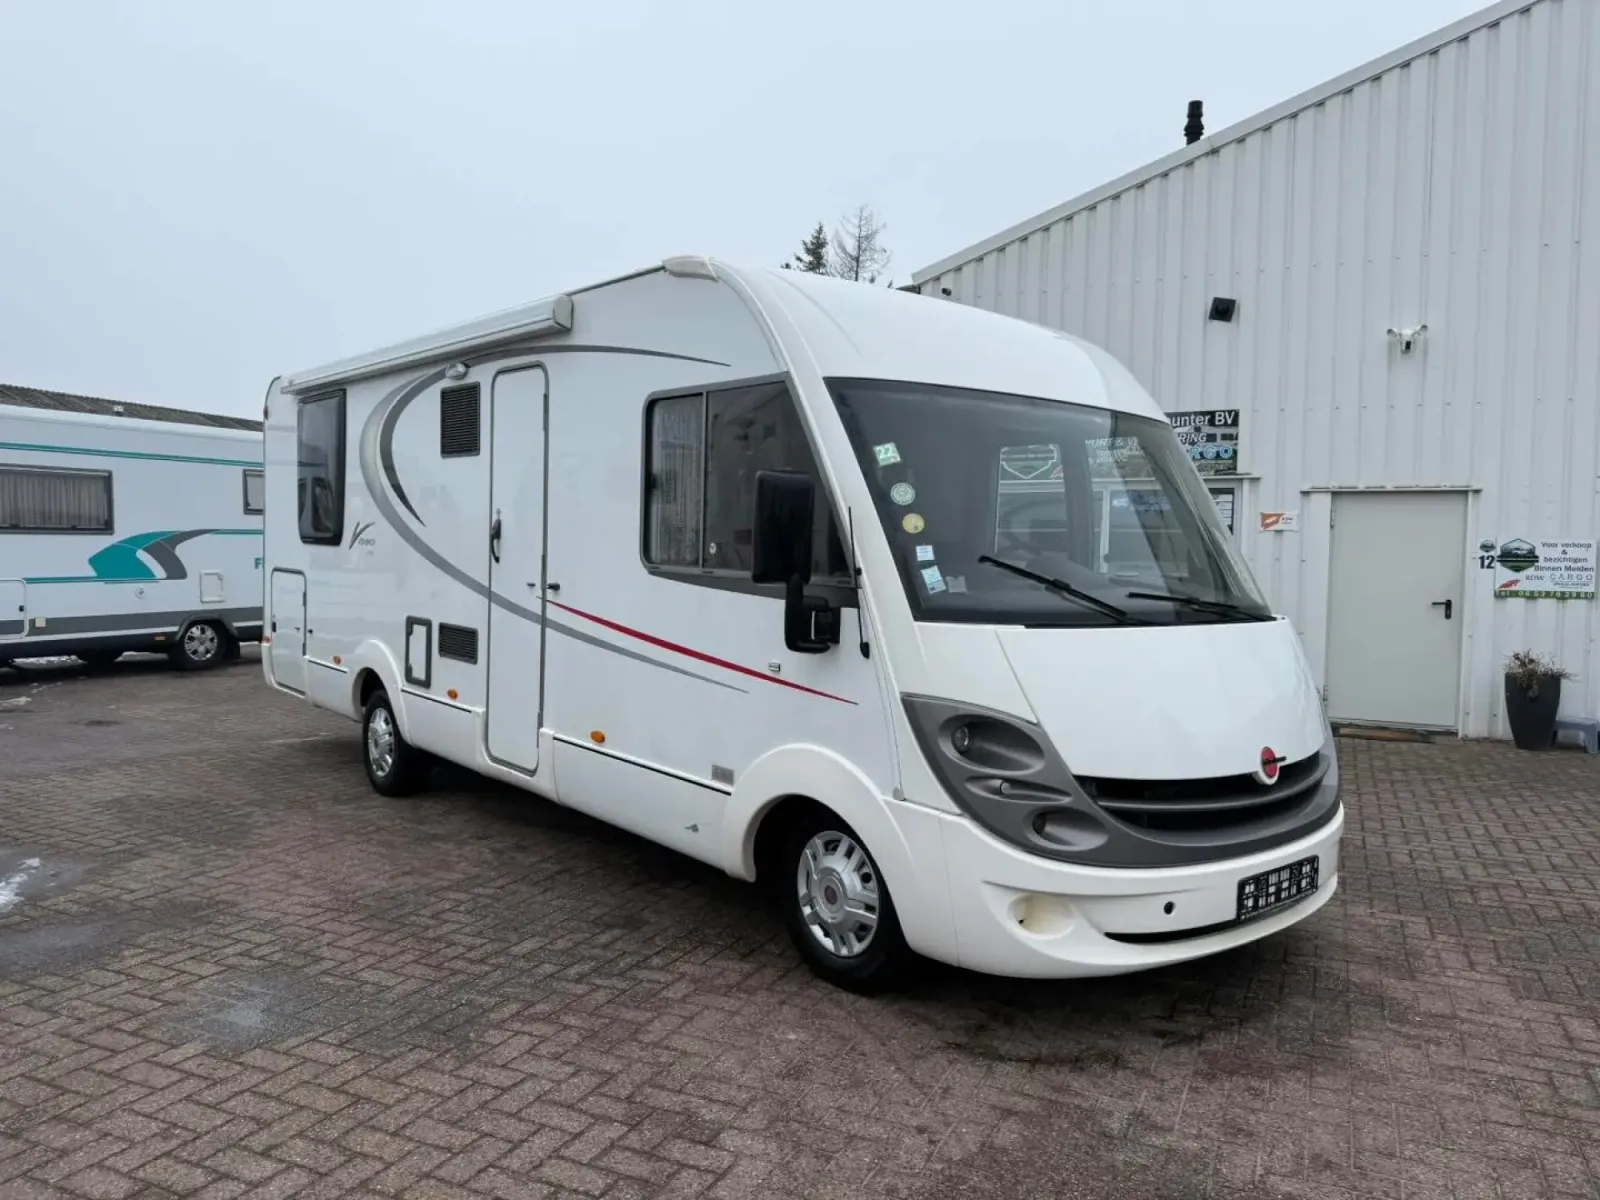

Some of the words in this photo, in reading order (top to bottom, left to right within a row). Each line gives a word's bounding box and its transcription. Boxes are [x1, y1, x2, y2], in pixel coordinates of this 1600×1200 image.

[1171, 413, 1211, 427] unter
[1215, 411, 1235, 425] BV
[1179, 432, 1207, 443] RING
[876, 444, 897, 458] 22
[1190, 445, 1233, 460] RGO
[1541, 541, 1558, 549] Voor
[1560, 541, 1592, 551] verkoop
[1479, 555, 1495, 569] 12
